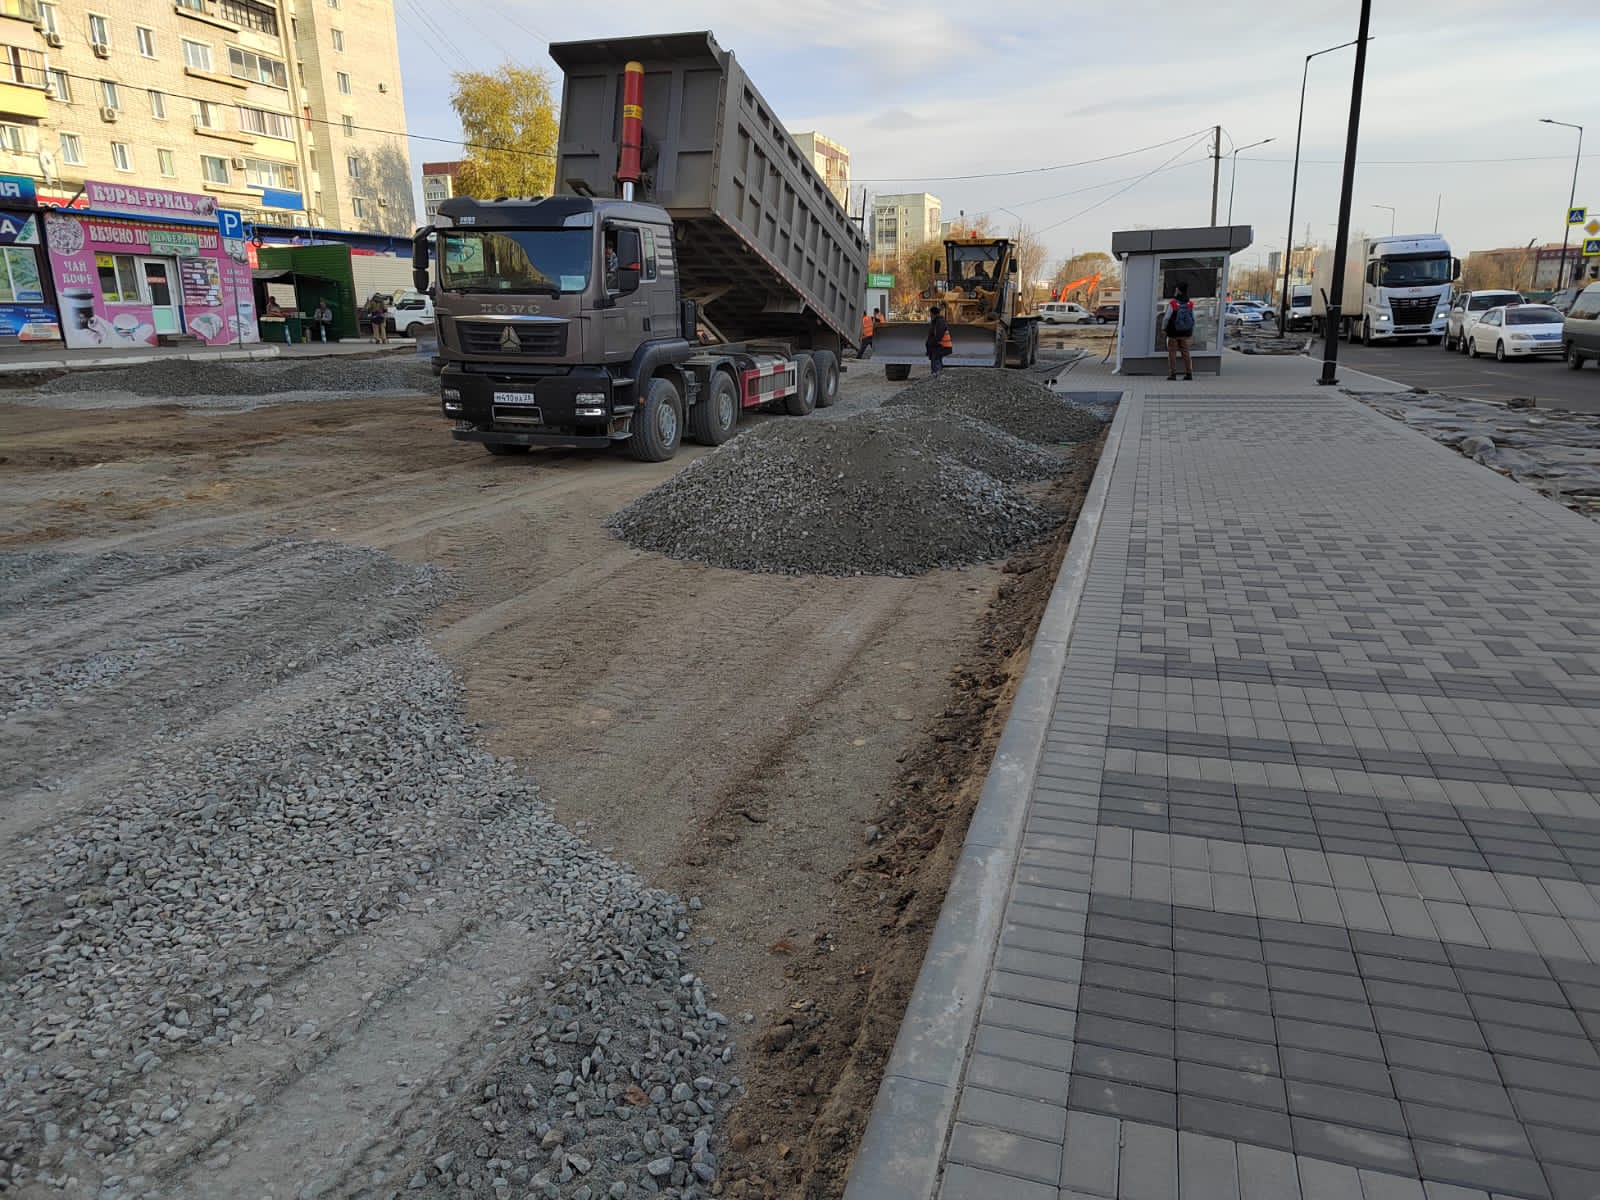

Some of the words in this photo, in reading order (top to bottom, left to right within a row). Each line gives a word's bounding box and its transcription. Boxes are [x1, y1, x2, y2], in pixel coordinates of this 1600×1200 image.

[92, 184, 194, 211] КУРЫ-ГРИЛЬ
[223, 213, 238, 236] P
[89, 225, 133, 244] ВКУСНО
[63, 260, 87, 272] ЧАЙ
[62, 273, 94, 285] КОФЕ
